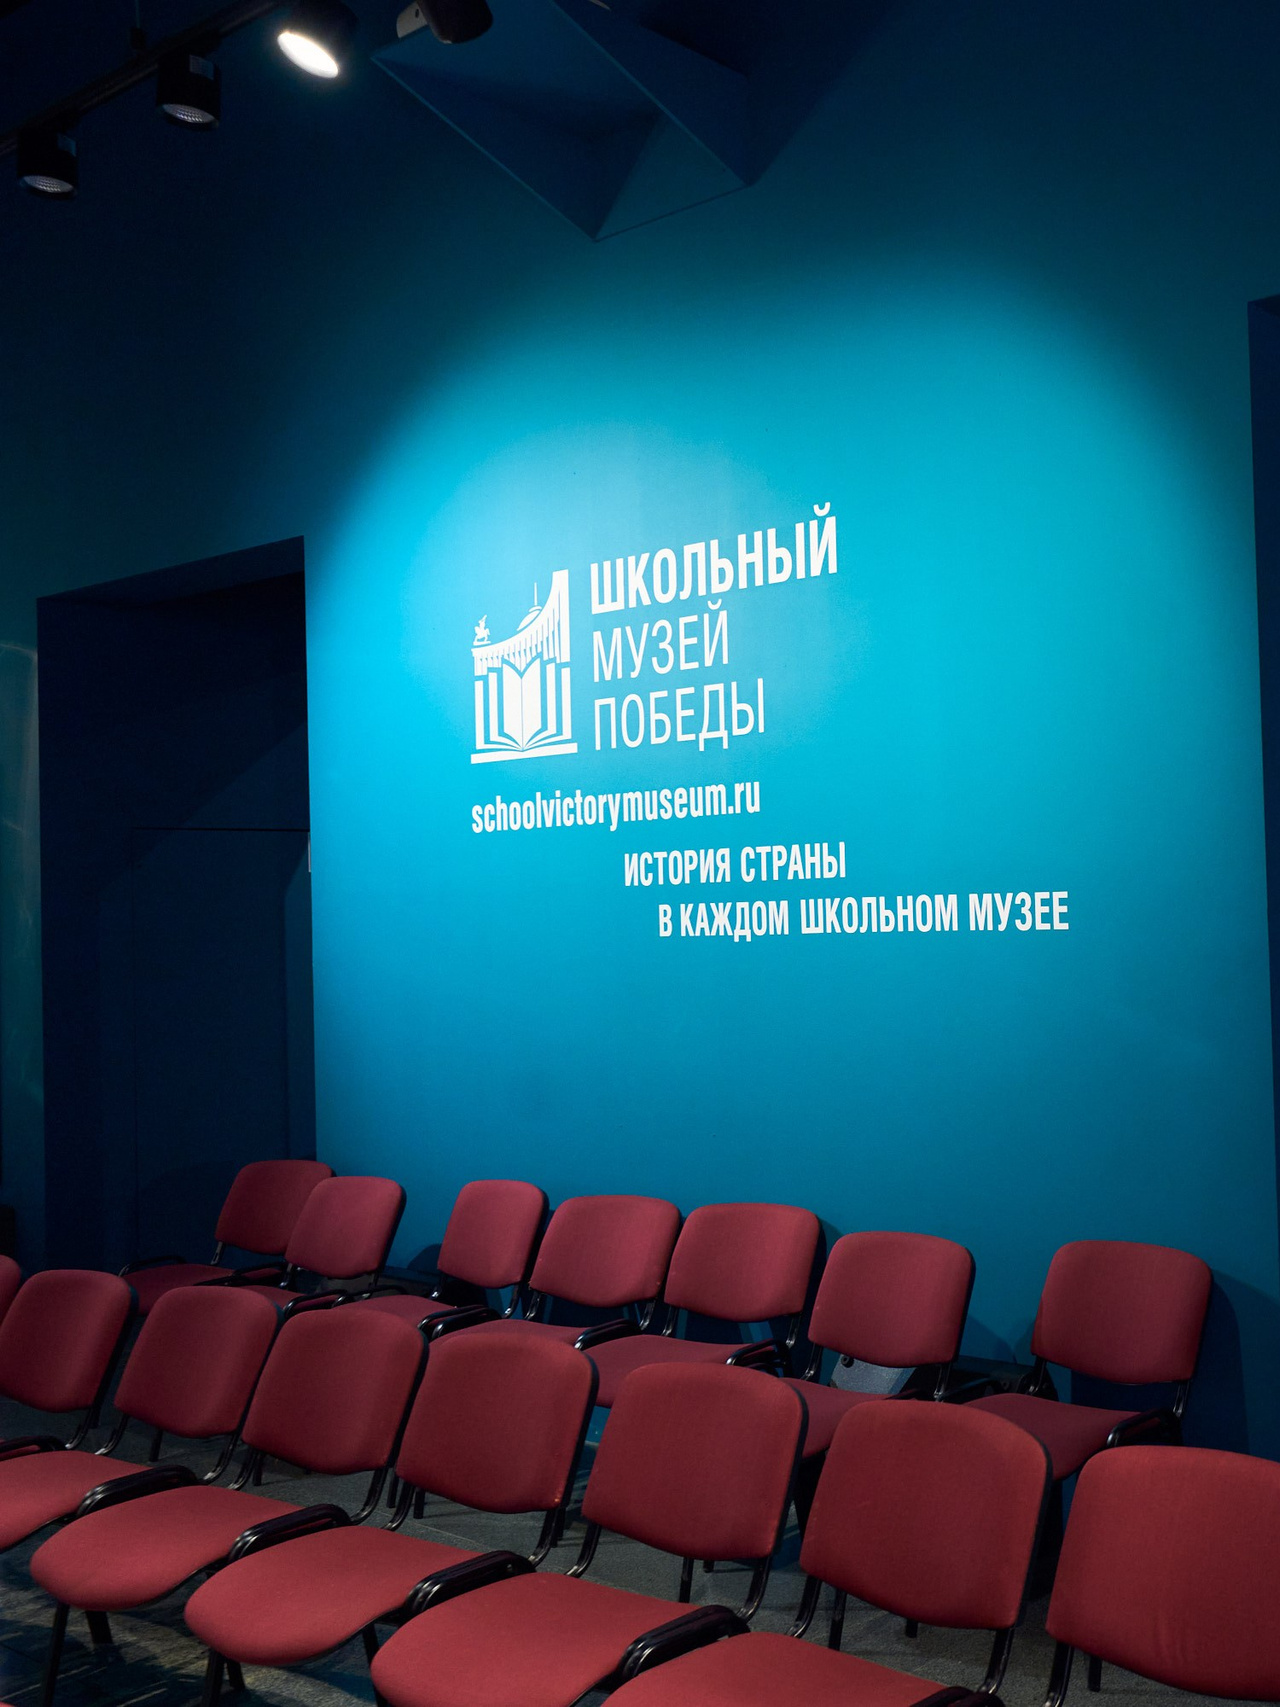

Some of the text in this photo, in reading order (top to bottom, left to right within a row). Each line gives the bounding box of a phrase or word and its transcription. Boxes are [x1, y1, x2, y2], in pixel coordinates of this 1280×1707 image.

[590, 502, 837, 615] ШКОЛЬНЫЙ
[593, 599, 728, 682] МУЗЕЙ
[594, 678, 765, 752] ПОБЕДЫ
[472, 782, 760, 833] schoolvictorymuseum.ru
[625, 842, 846, 887] ИСТОРИЯ СТРАНЫ
[658, 892, 1069, 942] В КАЖДОМ ШКОЛЬНОМ МУЗЕЕ
